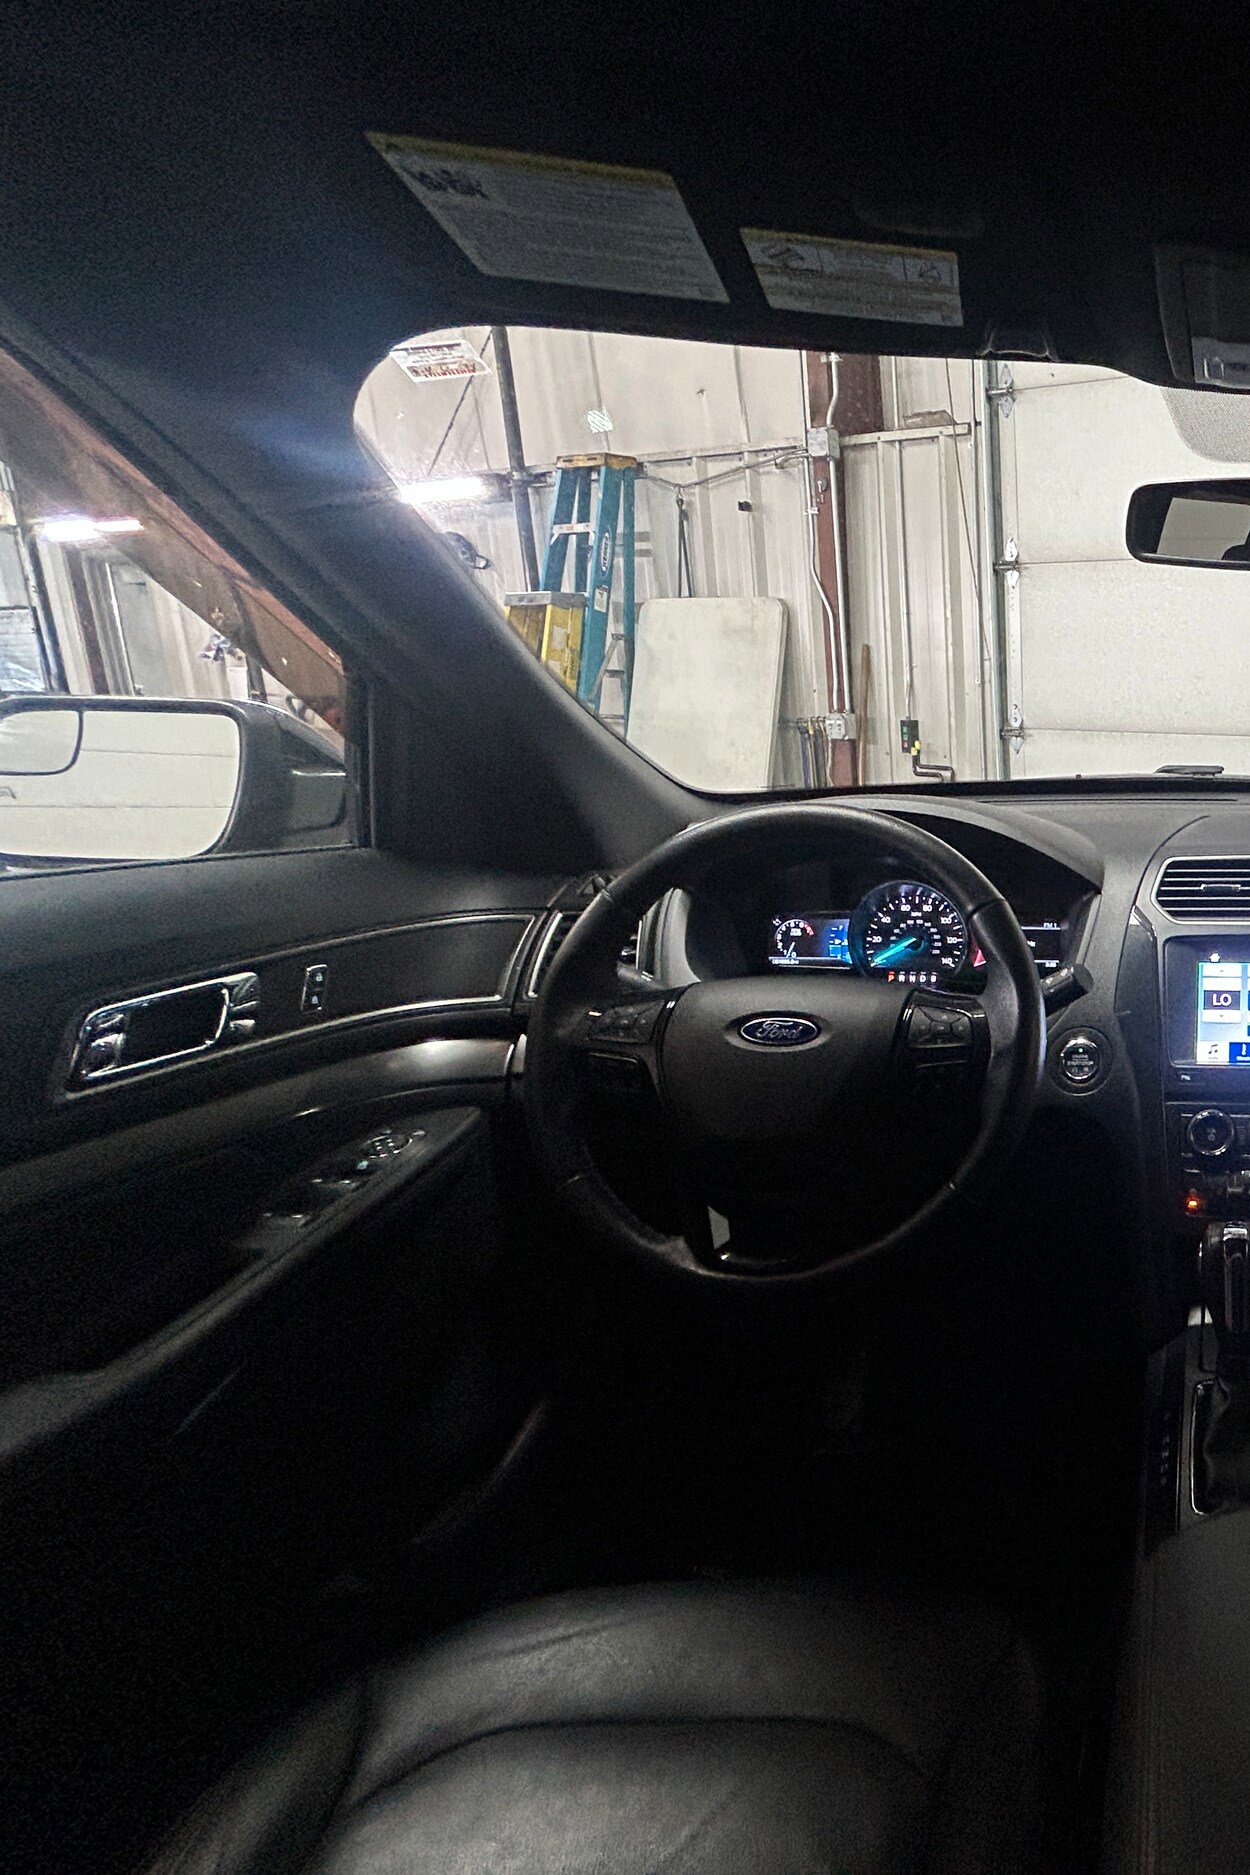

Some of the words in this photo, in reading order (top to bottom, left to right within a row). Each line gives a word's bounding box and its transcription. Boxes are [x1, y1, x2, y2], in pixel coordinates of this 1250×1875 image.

[900, 904, 911, 912] 60
[922, 904, 933, 912] 80
[946, 936, 957, 944] 120
[941, 957, 953, 965] 140
[1212, 993, 1232, 1006] LO
[757, 1020, 803, 1039] Ford
